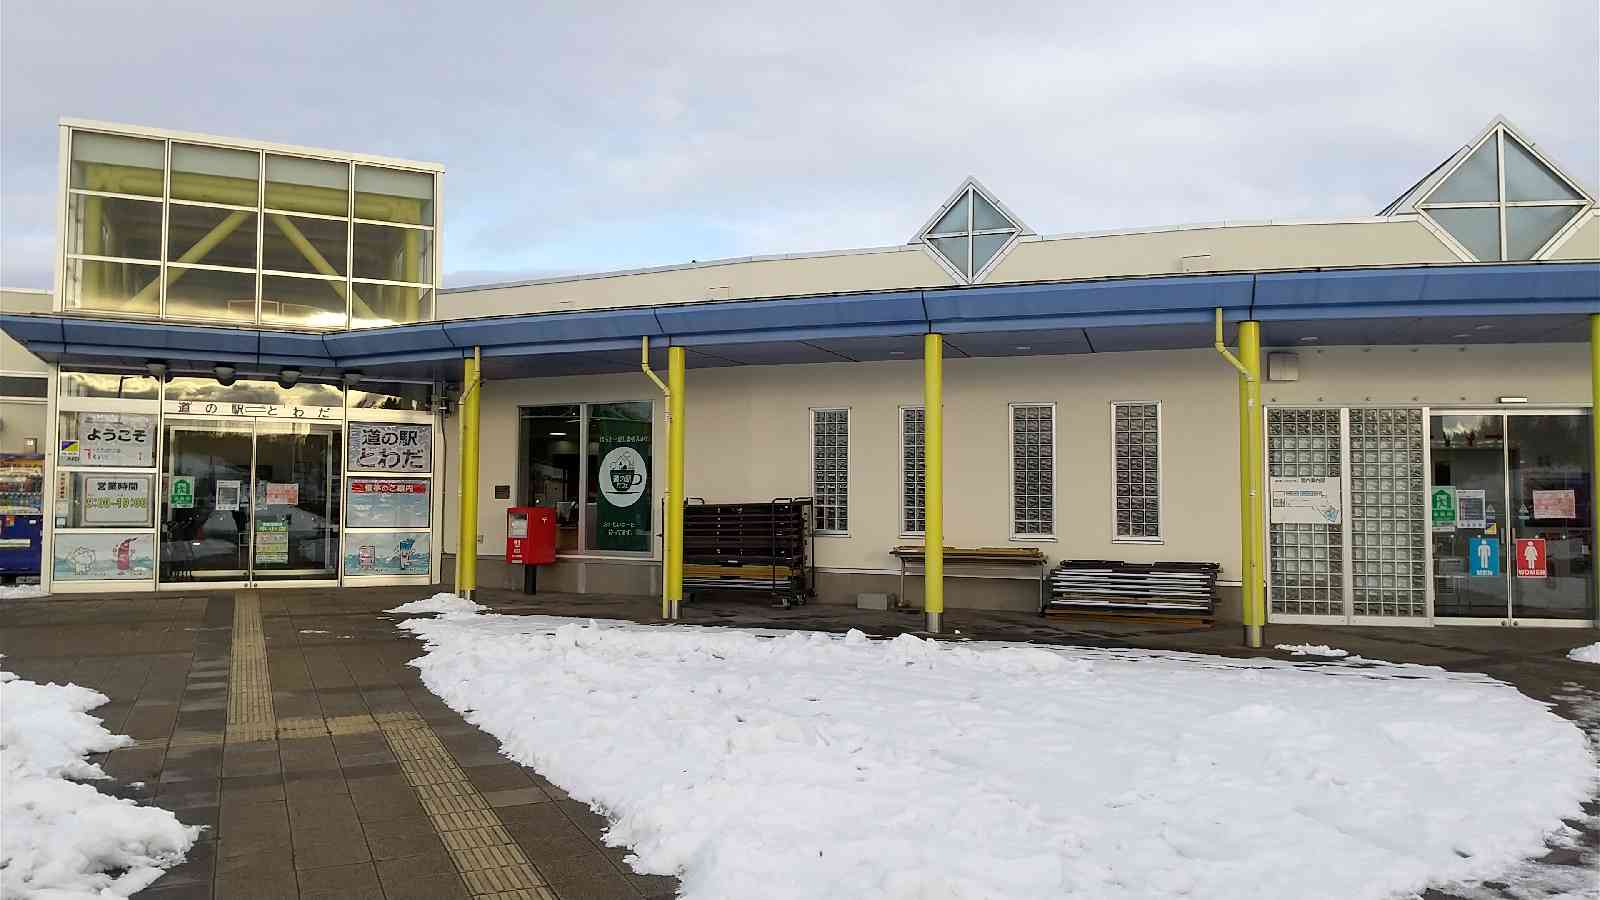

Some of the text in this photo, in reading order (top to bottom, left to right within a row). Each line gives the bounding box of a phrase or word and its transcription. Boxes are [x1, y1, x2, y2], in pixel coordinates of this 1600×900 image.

[178, 402, 330, 418] 道の駅 とわだ
[87, 428, 147, 442] ようこそ
[362, 428, 418, 446] 道の駅
[359, 449, 424, 469] とわだ
[97, 481, 139, 492] 営業時間
[1519, 569, 1546, 577] WOMEN
